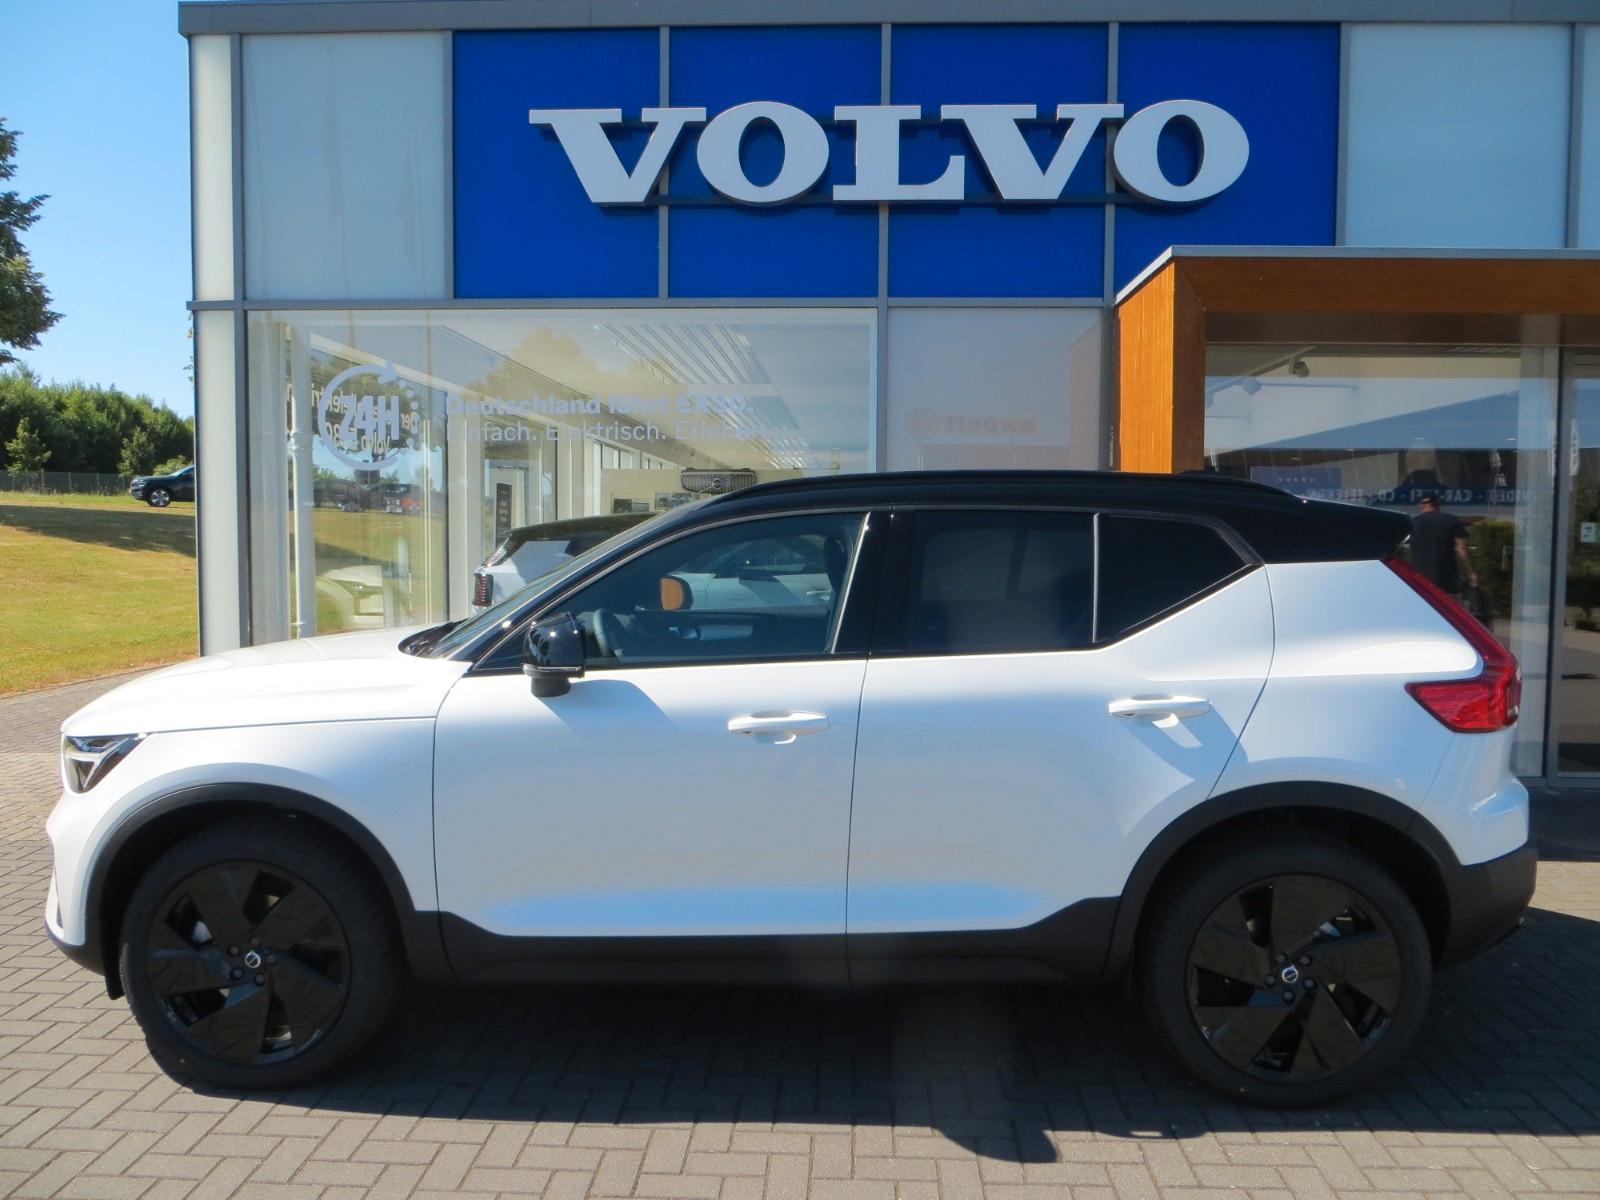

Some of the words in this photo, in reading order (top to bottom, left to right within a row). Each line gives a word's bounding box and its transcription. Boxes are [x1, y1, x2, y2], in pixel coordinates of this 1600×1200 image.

[529, 99, 1250, 203] VOLVO
[340, 395, 400, 441] 24H
[447, 391, 601, 414] Deutschland
[446, 420, 537, 442] Einfach.
[546, 420, 667, 442] Elektrisch.
